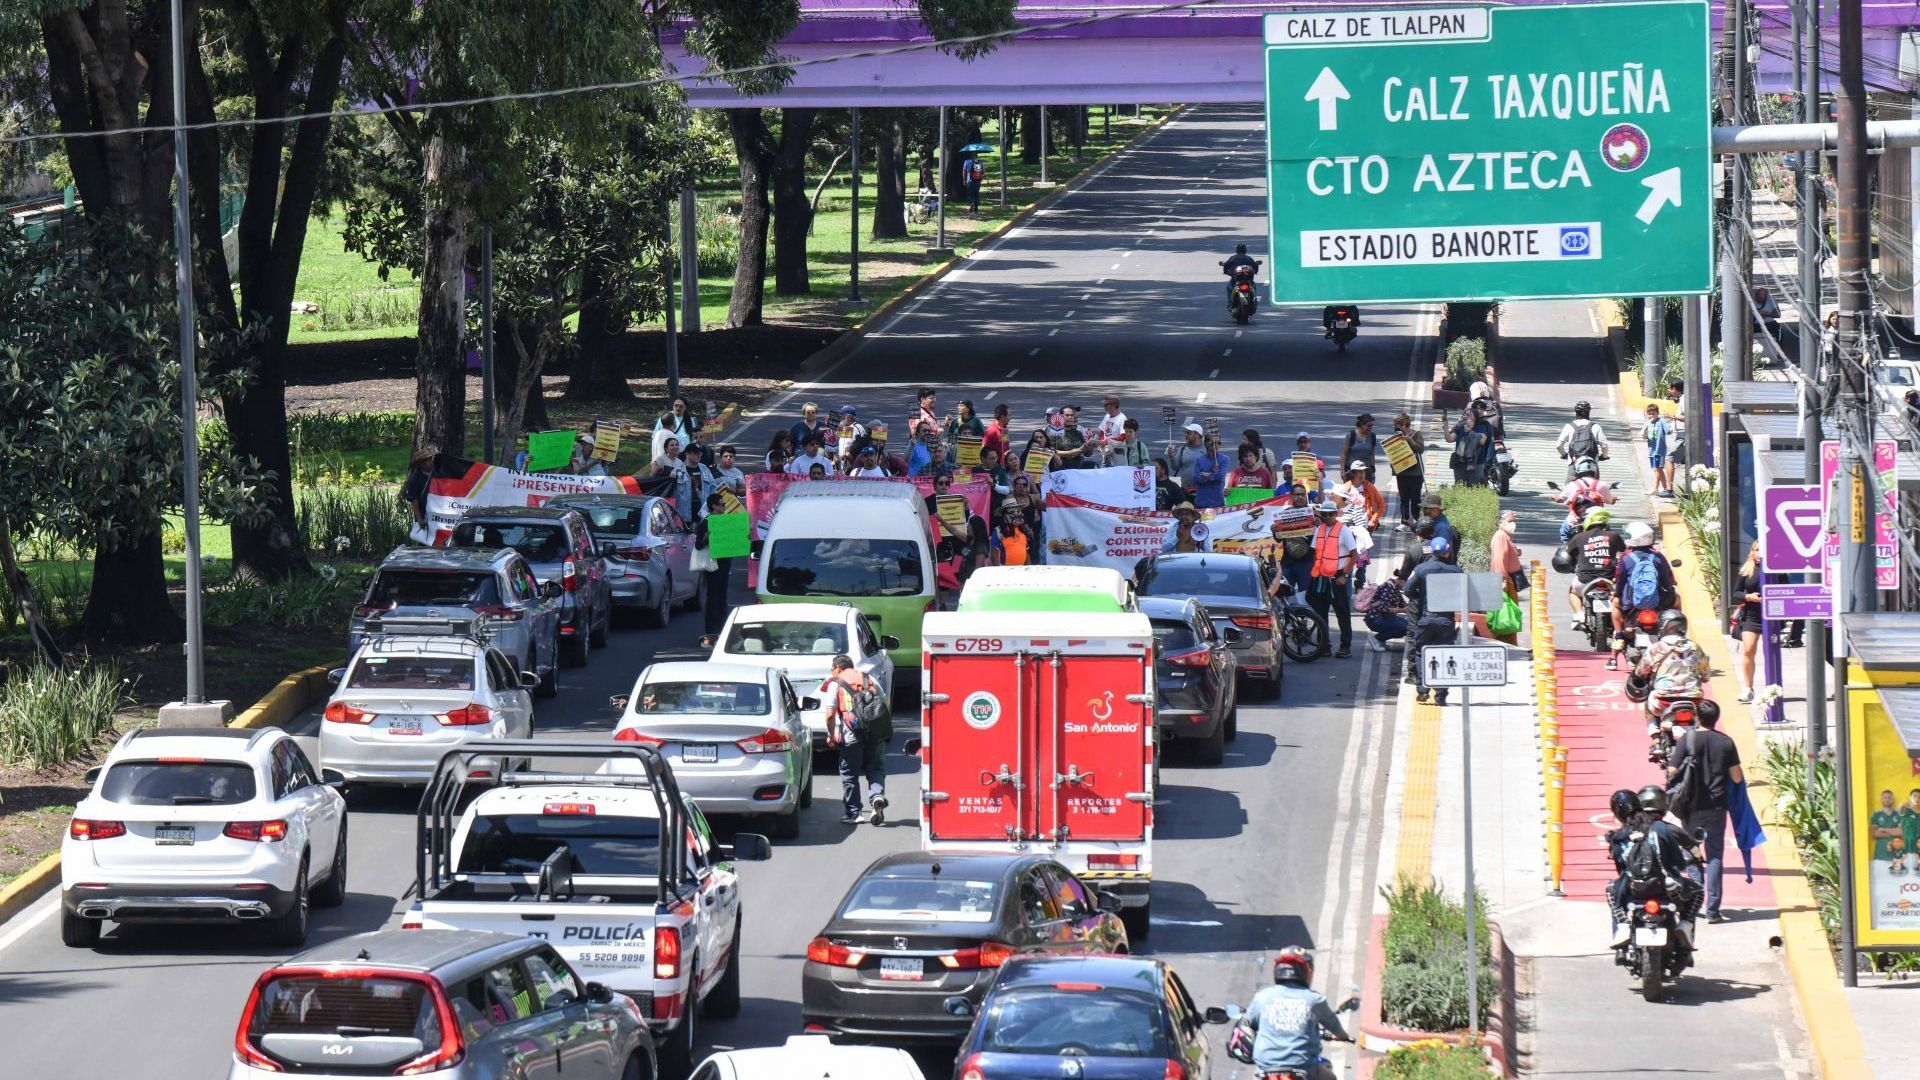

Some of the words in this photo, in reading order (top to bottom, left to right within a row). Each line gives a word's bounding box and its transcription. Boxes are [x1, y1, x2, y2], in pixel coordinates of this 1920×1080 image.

[1287, 19, 1335, 39] CALZ
[1347, 18, 1371, 37] DE
[1381, 14, 1466, 36] TLALPAN
[1384, 76, 1470, 122] CALZ
[1488, 62, 1671, 120] TAXQUEÑA
[1306, 154, 1390, 196] CTO
[1413, 149, 1592, 192] AZTECA
[1318, 234, 1418, 262] ESTADIO
[1432, 230, 1540, 258] BANORTE
[1114, 526, 1168, 534] EXIGIMO
[1106, 548, 1160, 557] COMPLE
[955, 638, 1003, 652] 6789
[1472, 652, 1503, 660] RESPETE
[1462, 662, 1476, 670] LAS
[1480, 662, 1503, 670] ZONAS
[1064, 722, 1088, 733] San
[1900, 883, 1920, 894] ¡CO
[563, 922, 645, 940] POLICÍA
[579, 952, 592, 960] 55
